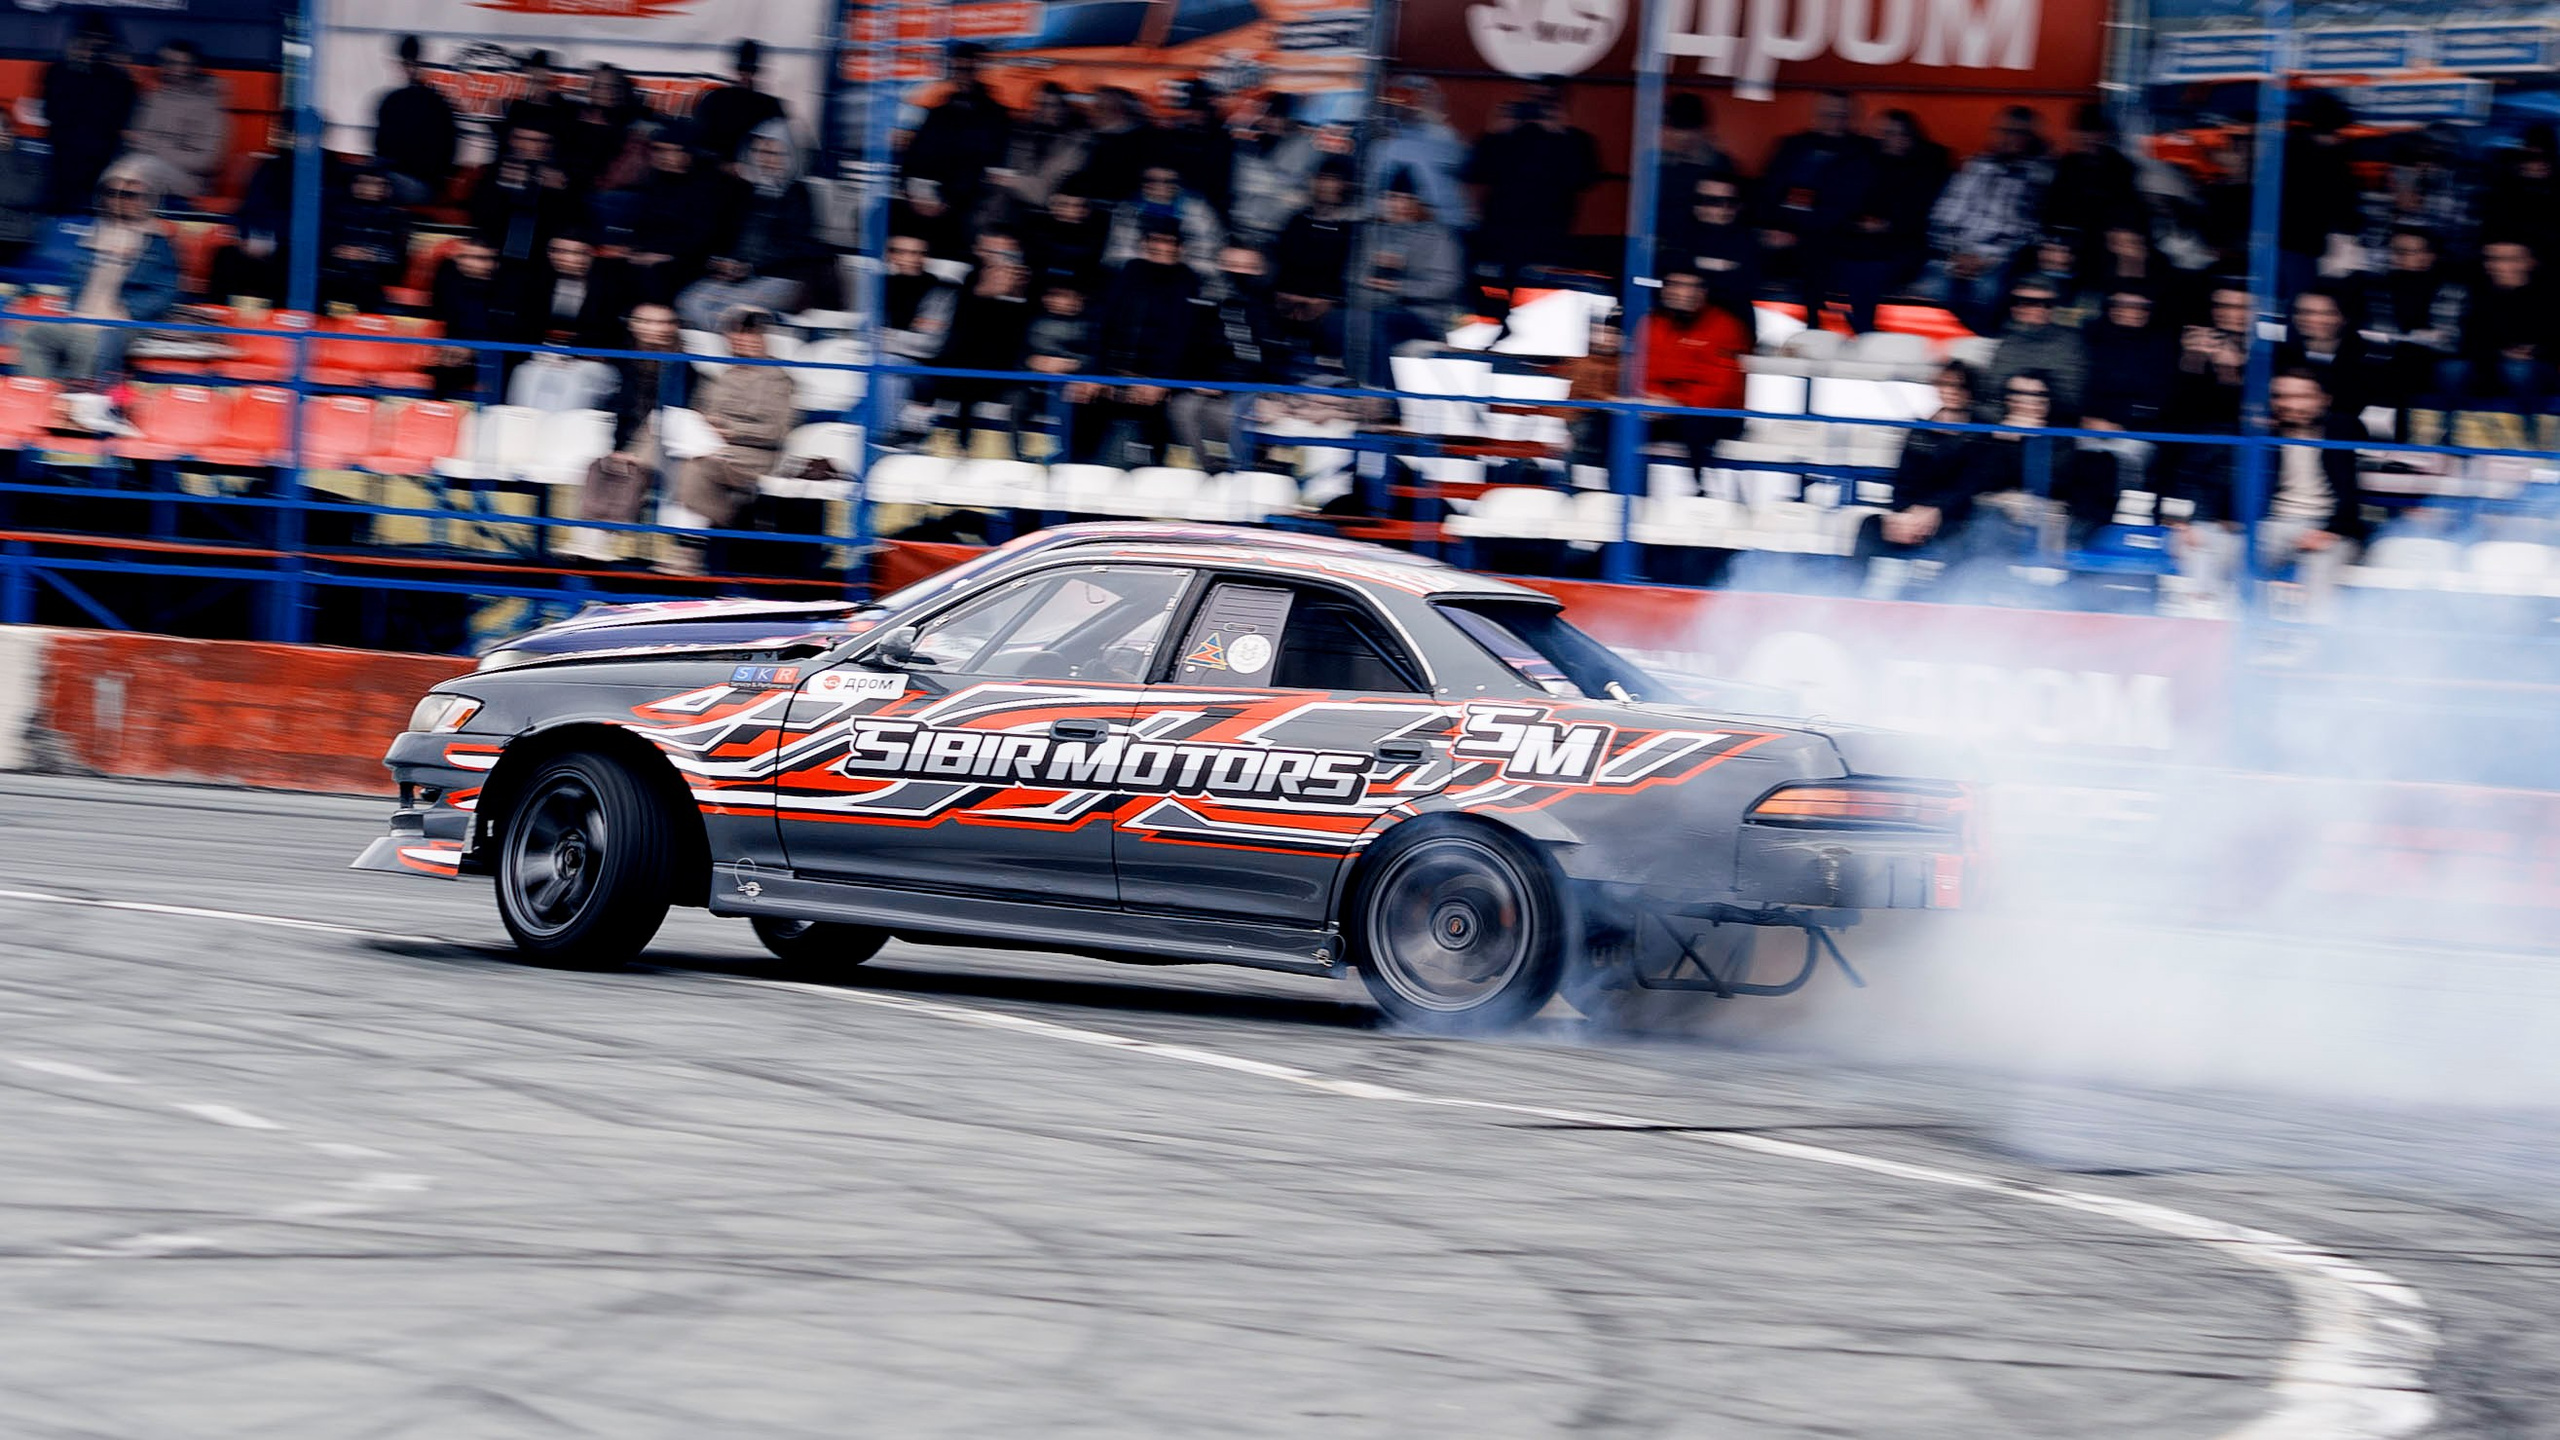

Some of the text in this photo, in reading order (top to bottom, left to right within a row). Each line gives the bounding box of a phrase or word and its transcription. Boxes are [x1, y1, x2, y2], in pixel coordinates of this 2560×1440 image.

[736, 667, 793, 682] SKR
[843, 677, 895, 693] дром
[846, 721, 1365, 798] SIBIR MOTORS
[1456, 703, 1602, 778] SM
